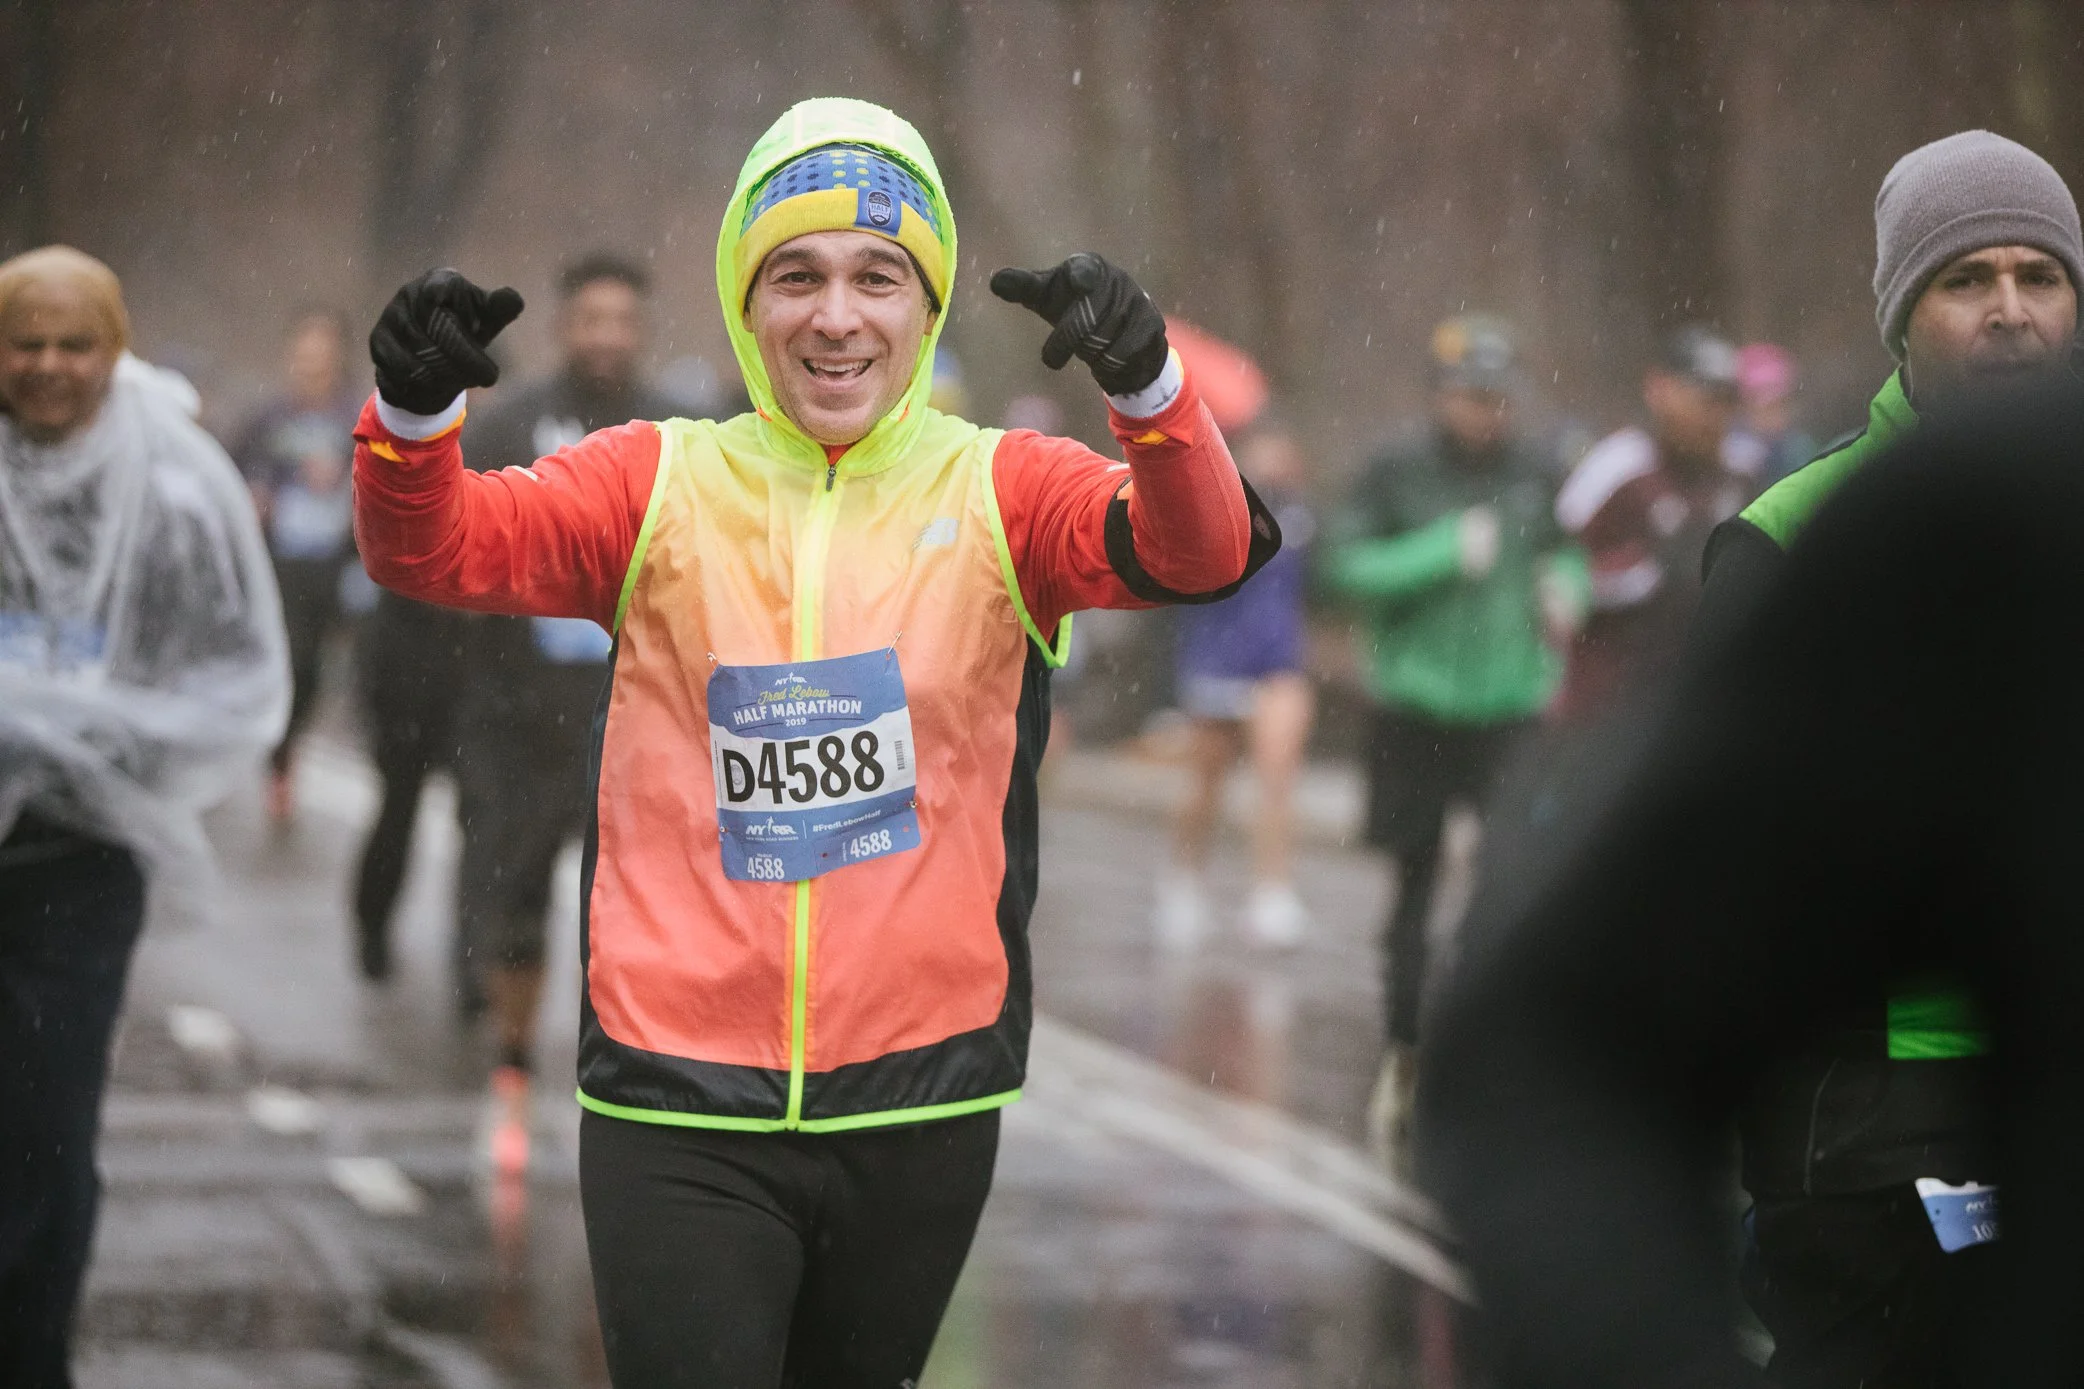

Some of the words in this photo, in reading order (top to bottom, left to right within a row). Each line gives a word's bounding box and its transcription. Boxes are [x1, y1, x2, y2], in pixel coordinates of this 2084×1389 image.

[757, 688, 787, 705] Fred
[789, 685, 830, 700] Lebow
[733, 706, 768, 725] HALF
[771, 700, 862, 718] MARATHON
[785, 717, 807, 727] 2019
[722, 730, 885, 804] D4588
[850, 829, 892, 858] 4588
[747, 857, 785, 880] 4588
